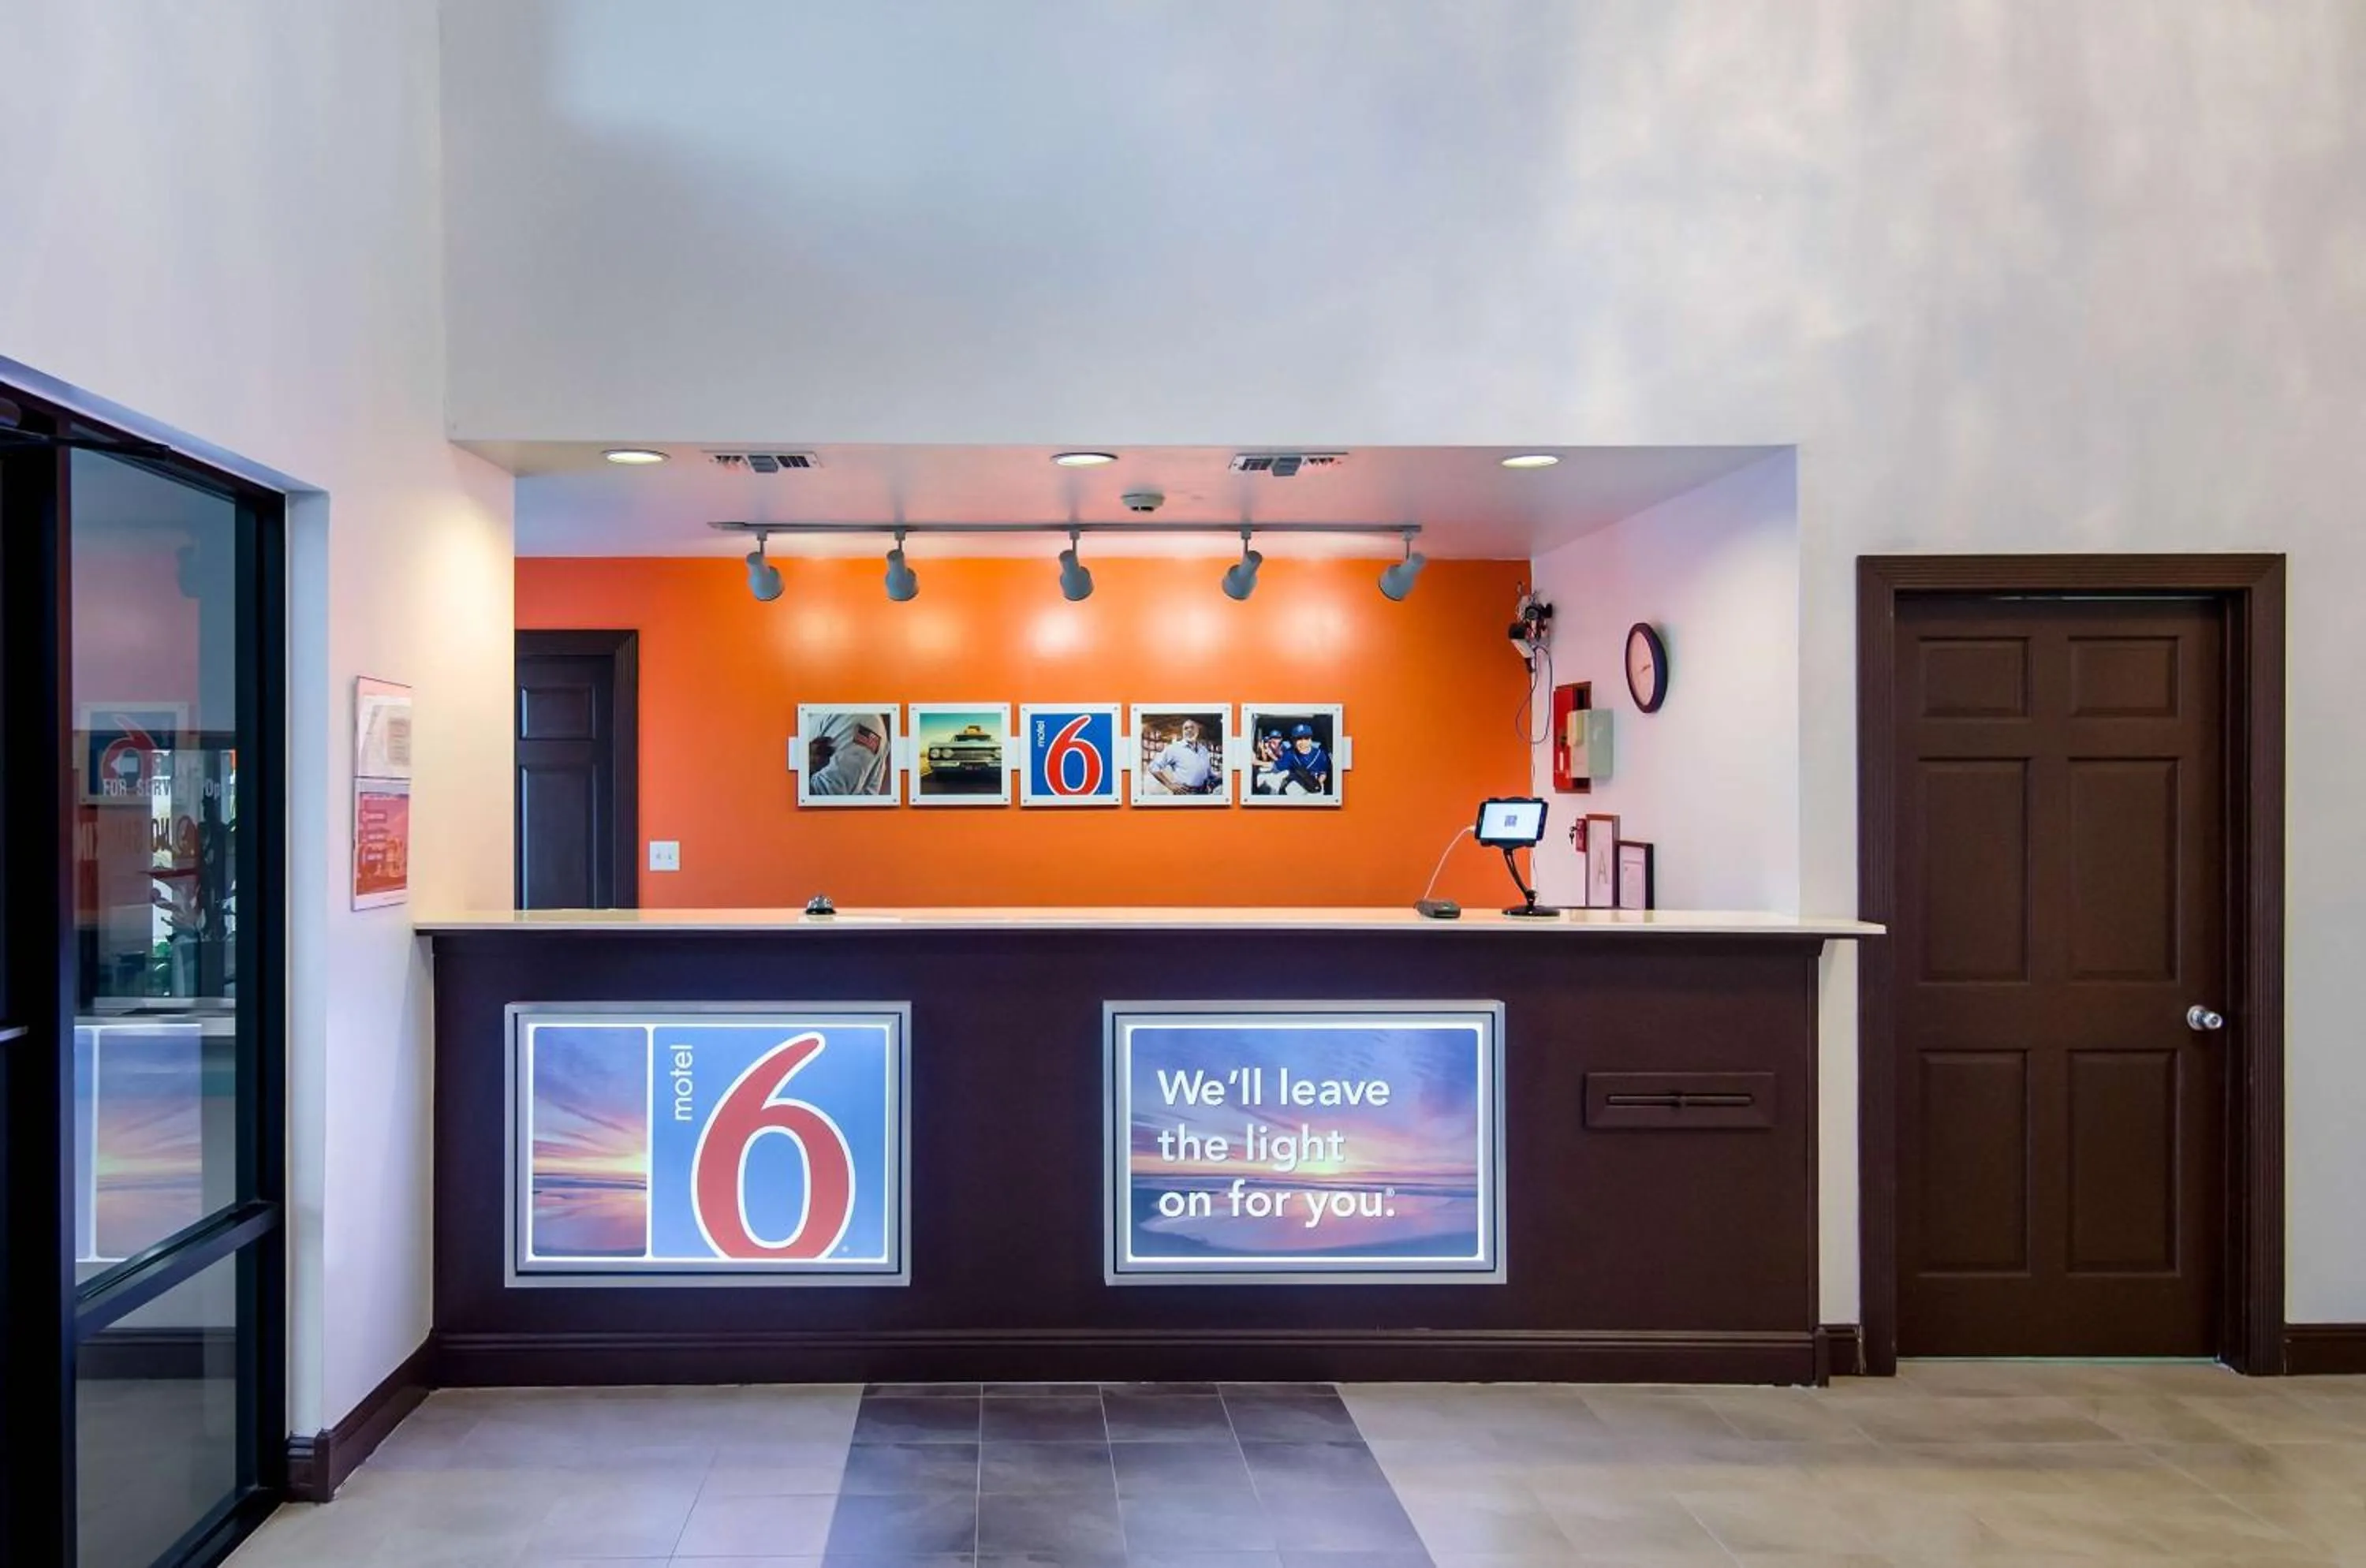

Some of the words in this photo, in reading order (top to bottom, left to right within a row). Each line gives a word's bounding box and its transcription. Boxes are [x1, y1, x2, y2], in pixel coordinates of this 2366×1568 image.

[1036, 720, 1045, 748] motel
[1044, 715, 1103, 795] 6
[103, 778, 127, 796] FOR
[670, 1044, 692, 1121] motel
[1281, 1068, 1390, 1106] leave
[691, 1031, 856, 1260] 6
[1157, 1123, 1228, 1162] the
[1247, 1123, 1345, 1173] light
[1158, 1191, 1211, 1218] on
[1229, 1179, 1291, 1218] for
